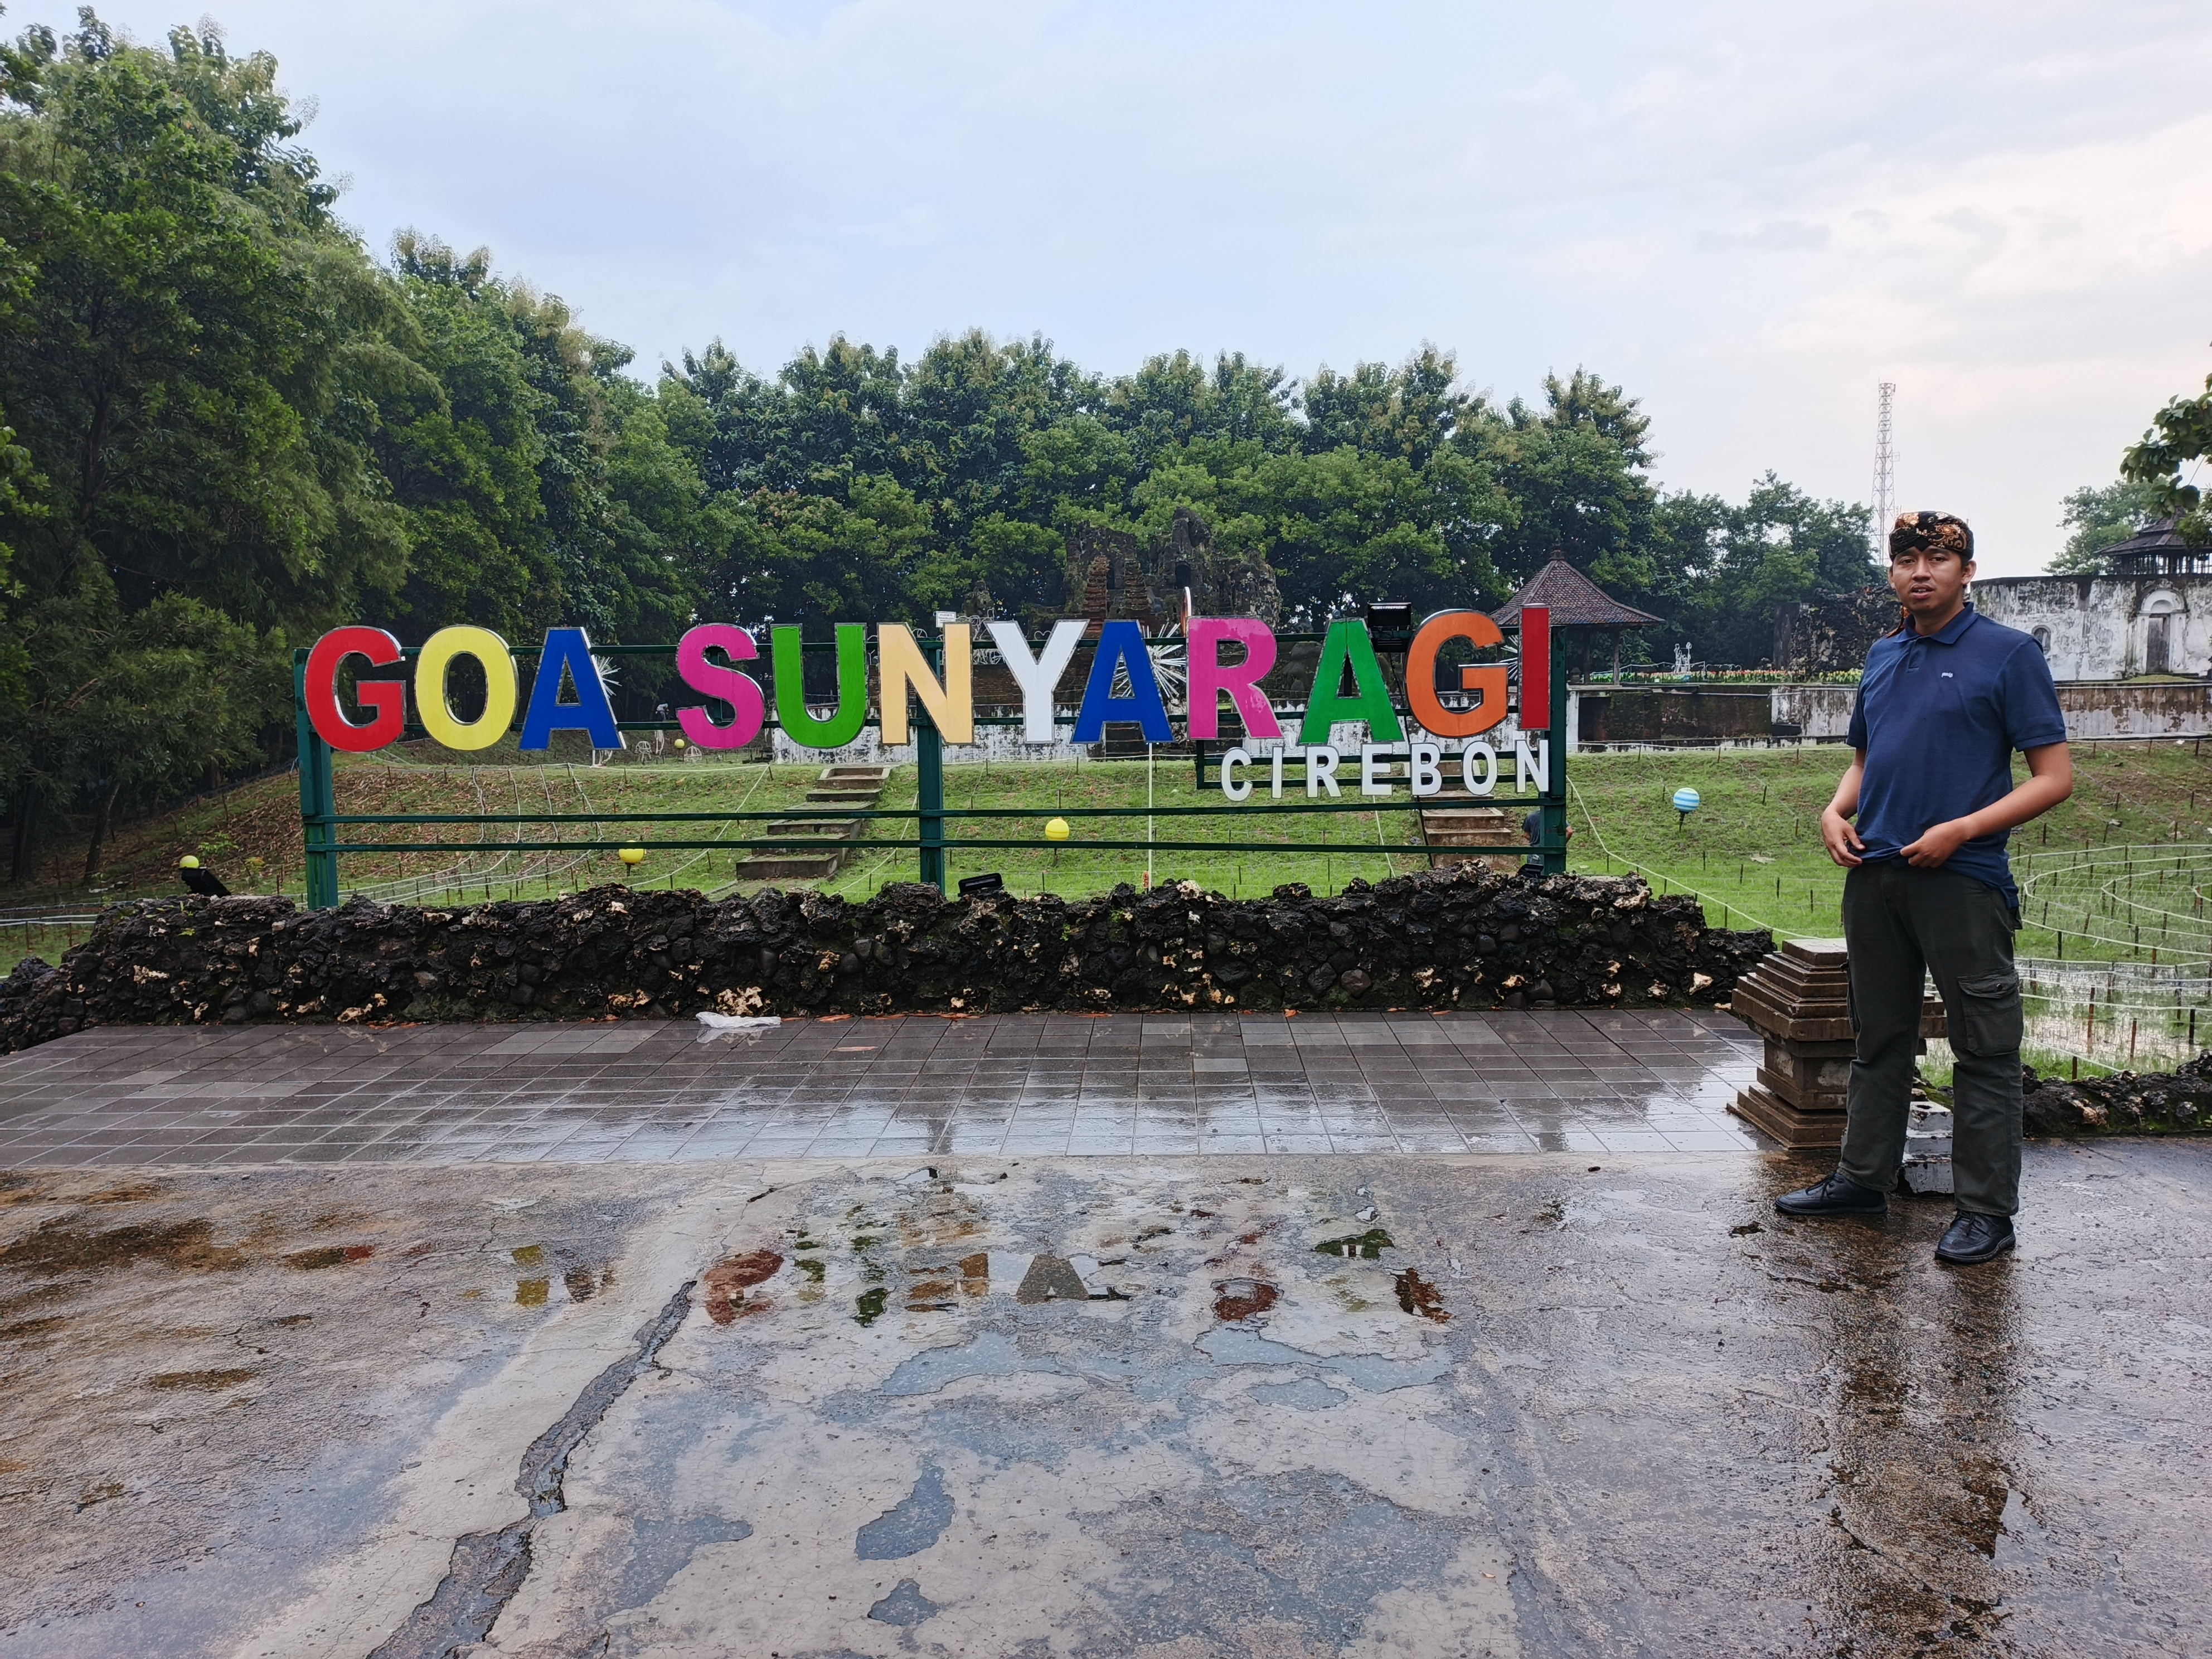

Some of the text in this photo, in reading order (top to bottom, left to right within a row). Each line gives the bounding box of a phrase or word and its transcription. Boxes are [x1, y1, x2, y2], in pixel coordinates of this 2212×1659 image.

[304, 604, 1551, 753] GOA SUNYARAGI
[1221, 739, 1550, 802] CIREBON
